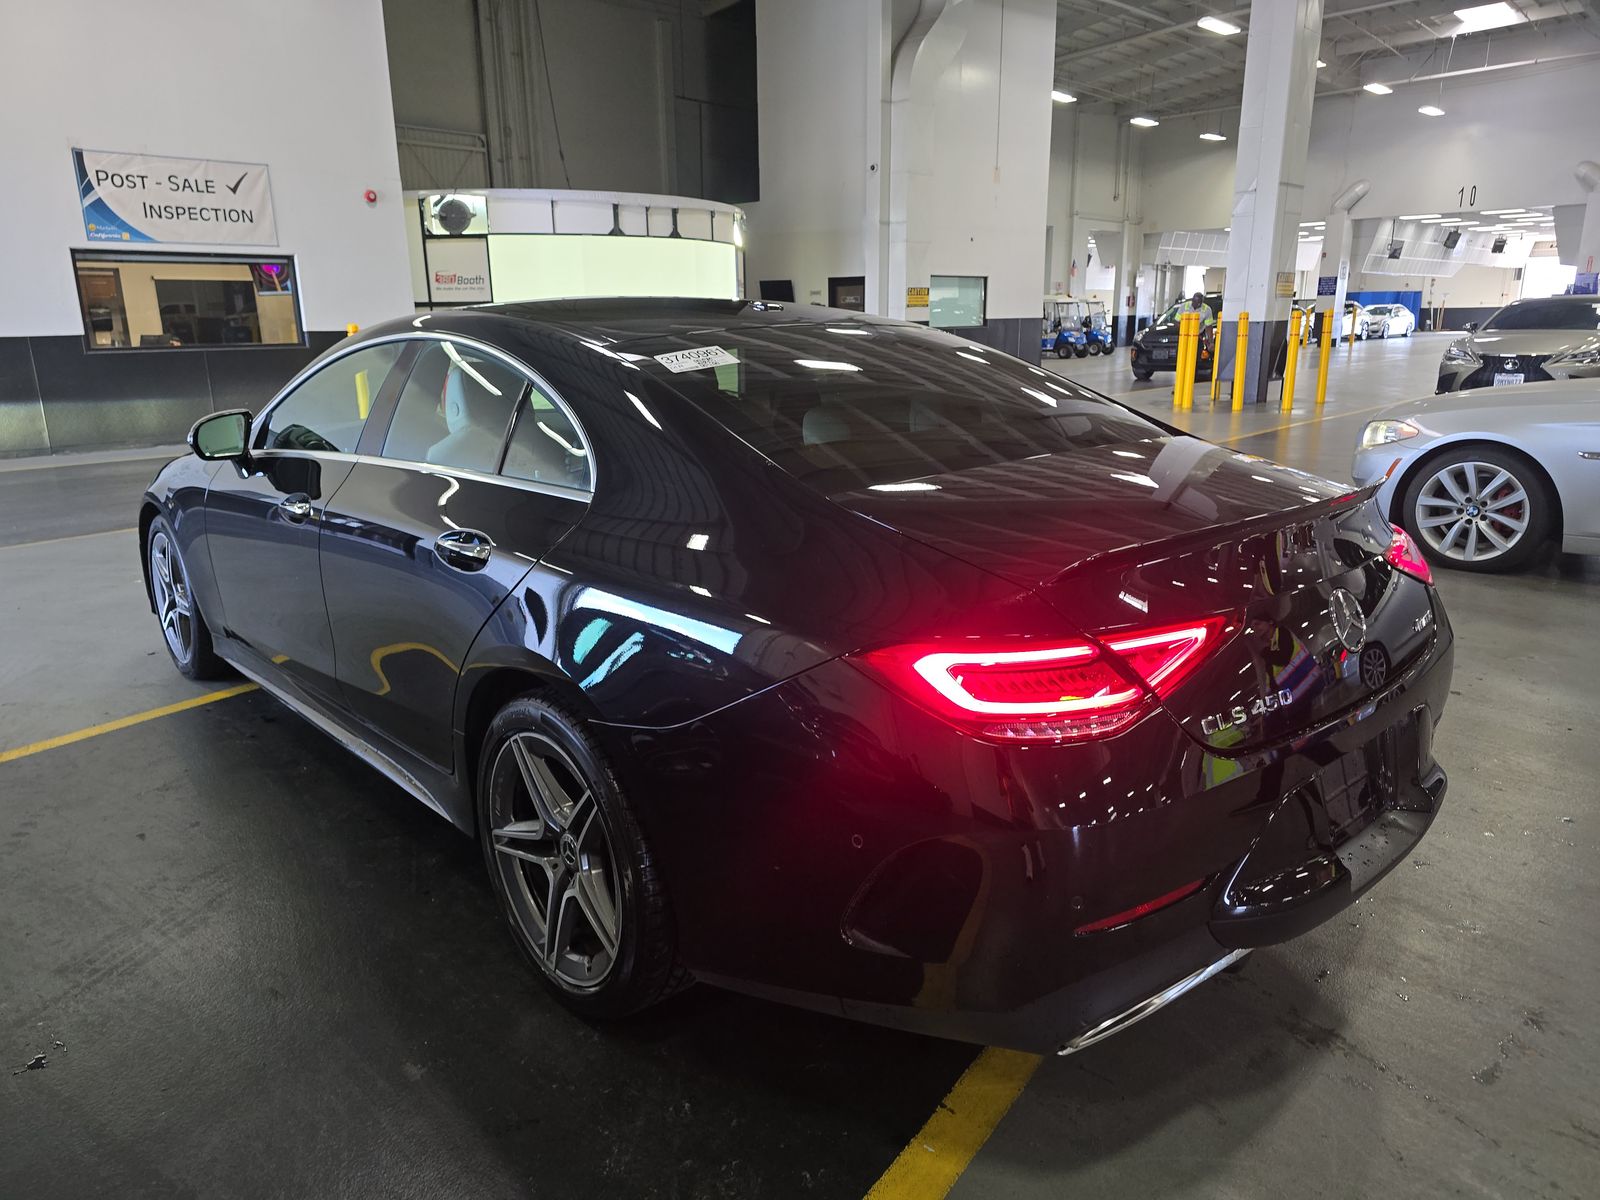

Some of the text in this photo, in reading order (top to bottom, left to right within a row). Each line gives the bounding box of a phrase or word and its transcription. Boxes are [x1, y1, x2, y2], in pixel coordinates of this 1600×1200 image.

[95, 170, 148, 190] POST
[168, 175, 216, 194] SALE
[1458, 185, 1477, 208] 10
[143, 202, 254, 223] INSPECTION
[457, 274, 485, 285] Booth
[1201, 706, 1248, 735] CLS
